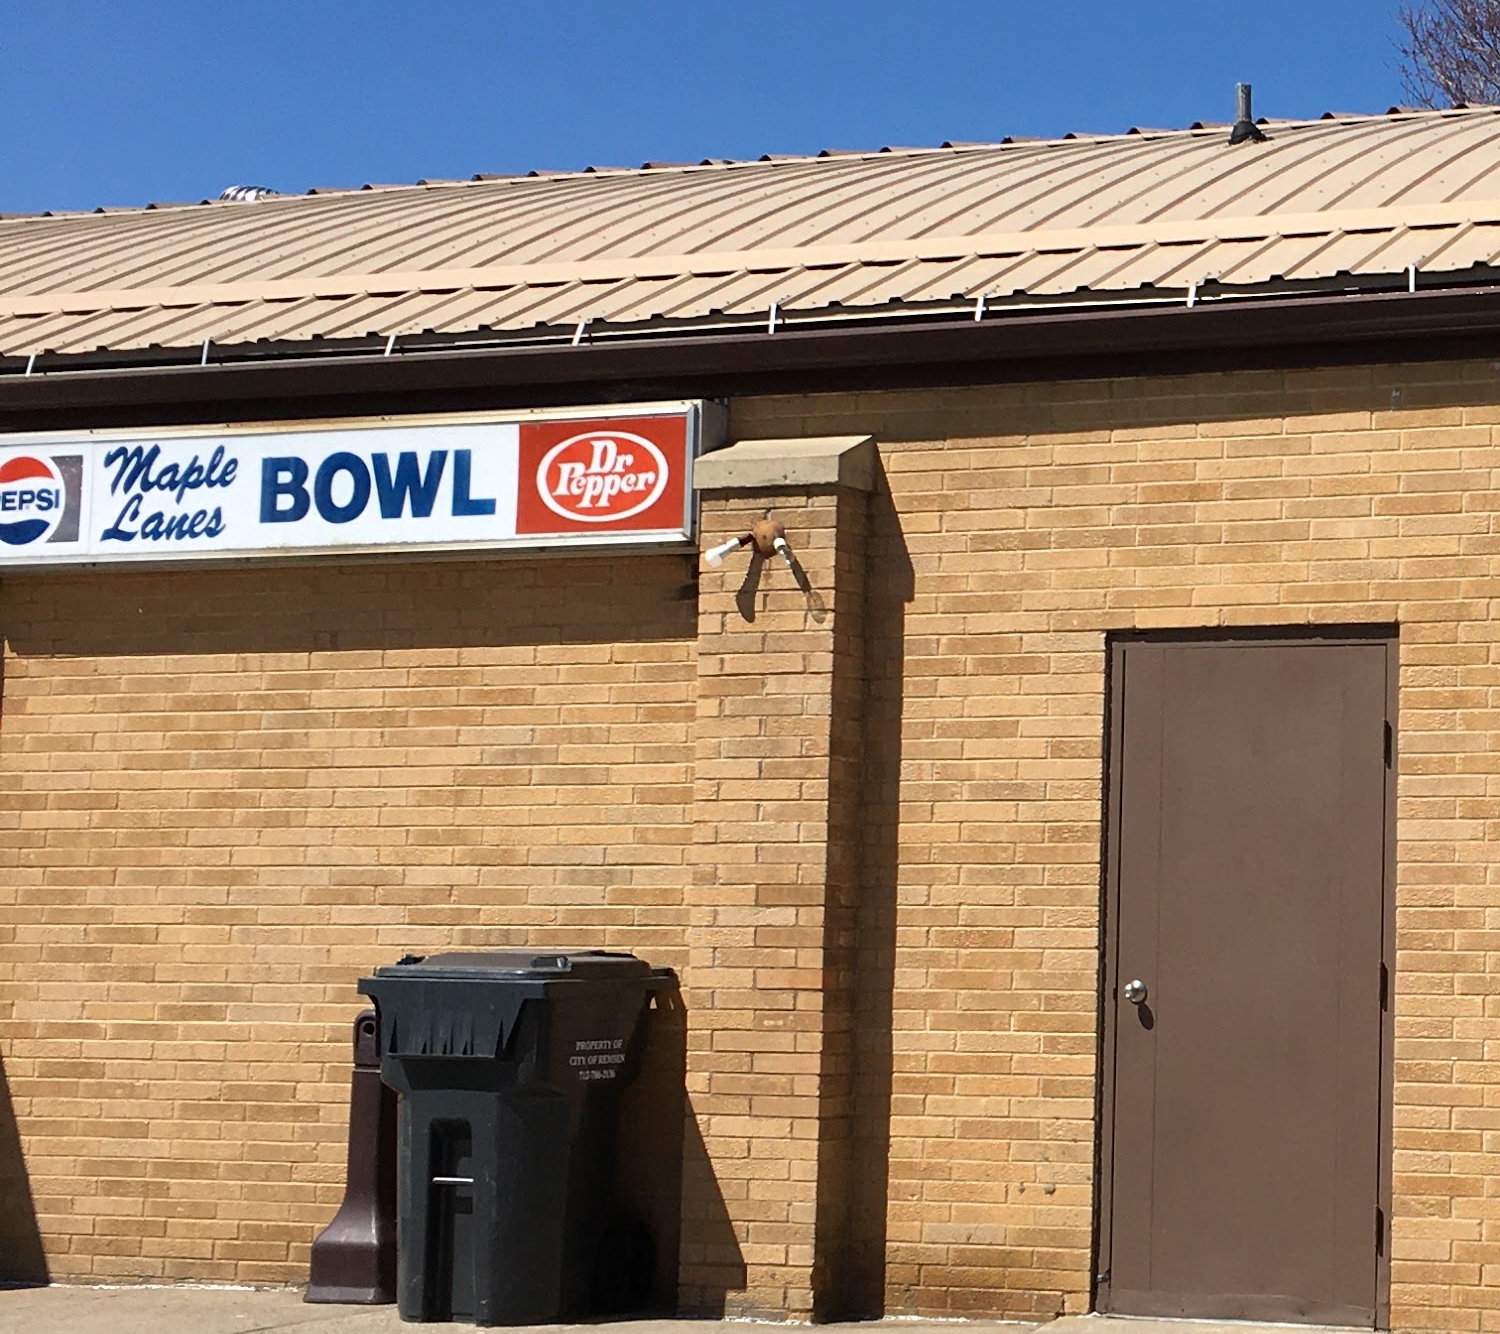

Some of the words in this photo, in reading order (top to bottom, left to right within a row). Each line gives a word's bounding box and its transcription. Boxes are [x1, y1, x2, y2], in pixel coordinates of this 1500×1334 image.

[103, 443, 238, 505] Maple
[585, 439, 635, 474] Dr
[0, 488, 60, 511] EPSI
[259, 449, 497, 524] BOWL
[552, 462, 656, 508] Pepper
[100, 492, 227, 543] Lanes
[569, 1056, 586, 1066] CITY
[587, 1055, 597, 1065] OF
[576, 1040, 611, 1050] PROPERTY
[613, 1039, 623, 1049] OF
